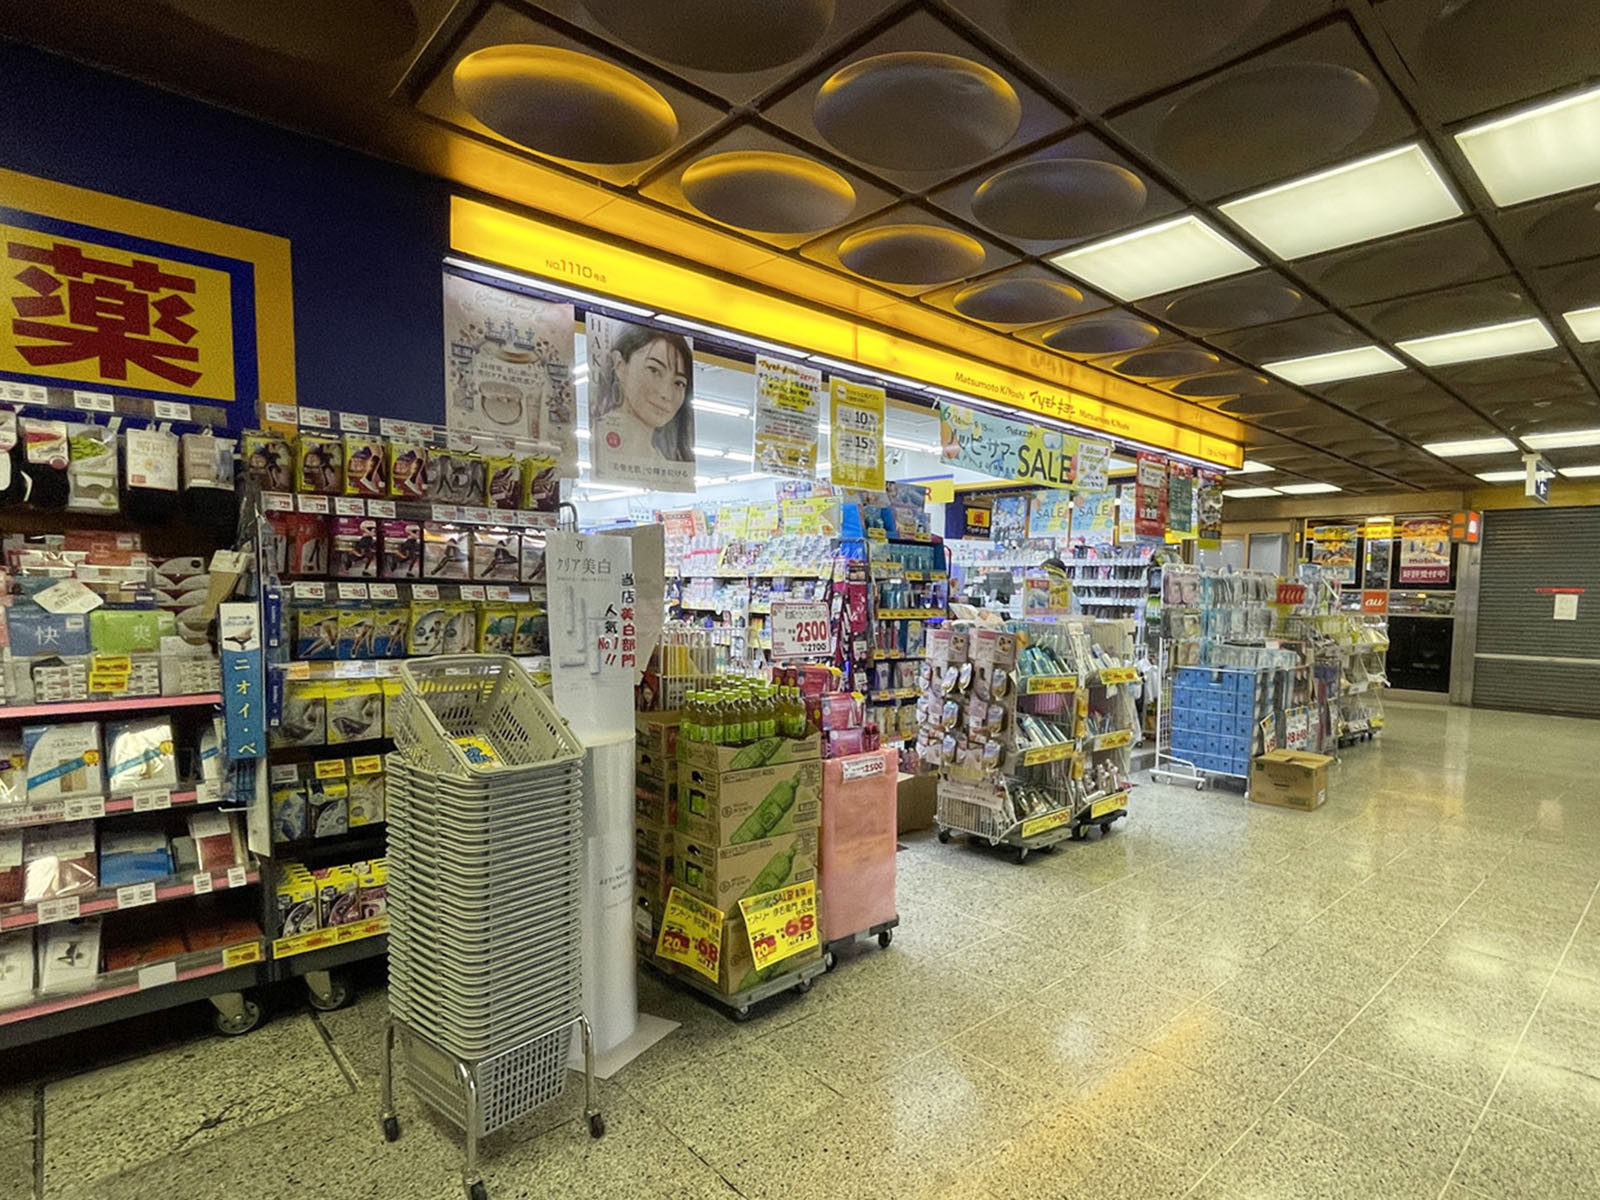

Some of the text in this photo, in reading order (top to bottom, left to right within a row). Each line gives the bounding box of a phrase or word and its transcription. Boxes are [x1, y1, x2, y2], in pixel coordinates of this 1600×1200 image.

[7, 241, 203, 388] 薬
[954, 371, 999, 395] Matsumoto
[1029, 389, 1076, 416] マツモトキヨシ
[1078, 408, 1110, 426] Matsumoto
[950, 429, 1016, 460] ハッピーサマー
[1017, 444, 1074, 485] SALE
[1036, 506, 1064, 520] SALE
[1078, 503, 1109, 518] SALE
[557, 558, 612, 575] クリア美白
[1364, 598, 1386, 607] au
[620, 572, 636, 668] 当店美白部門
[796, 620, 827, 643] 2500
[34, 625, 61, 646] 快
[785, 913, 815, 937] 68
[699, 937, 718, 964] 68
